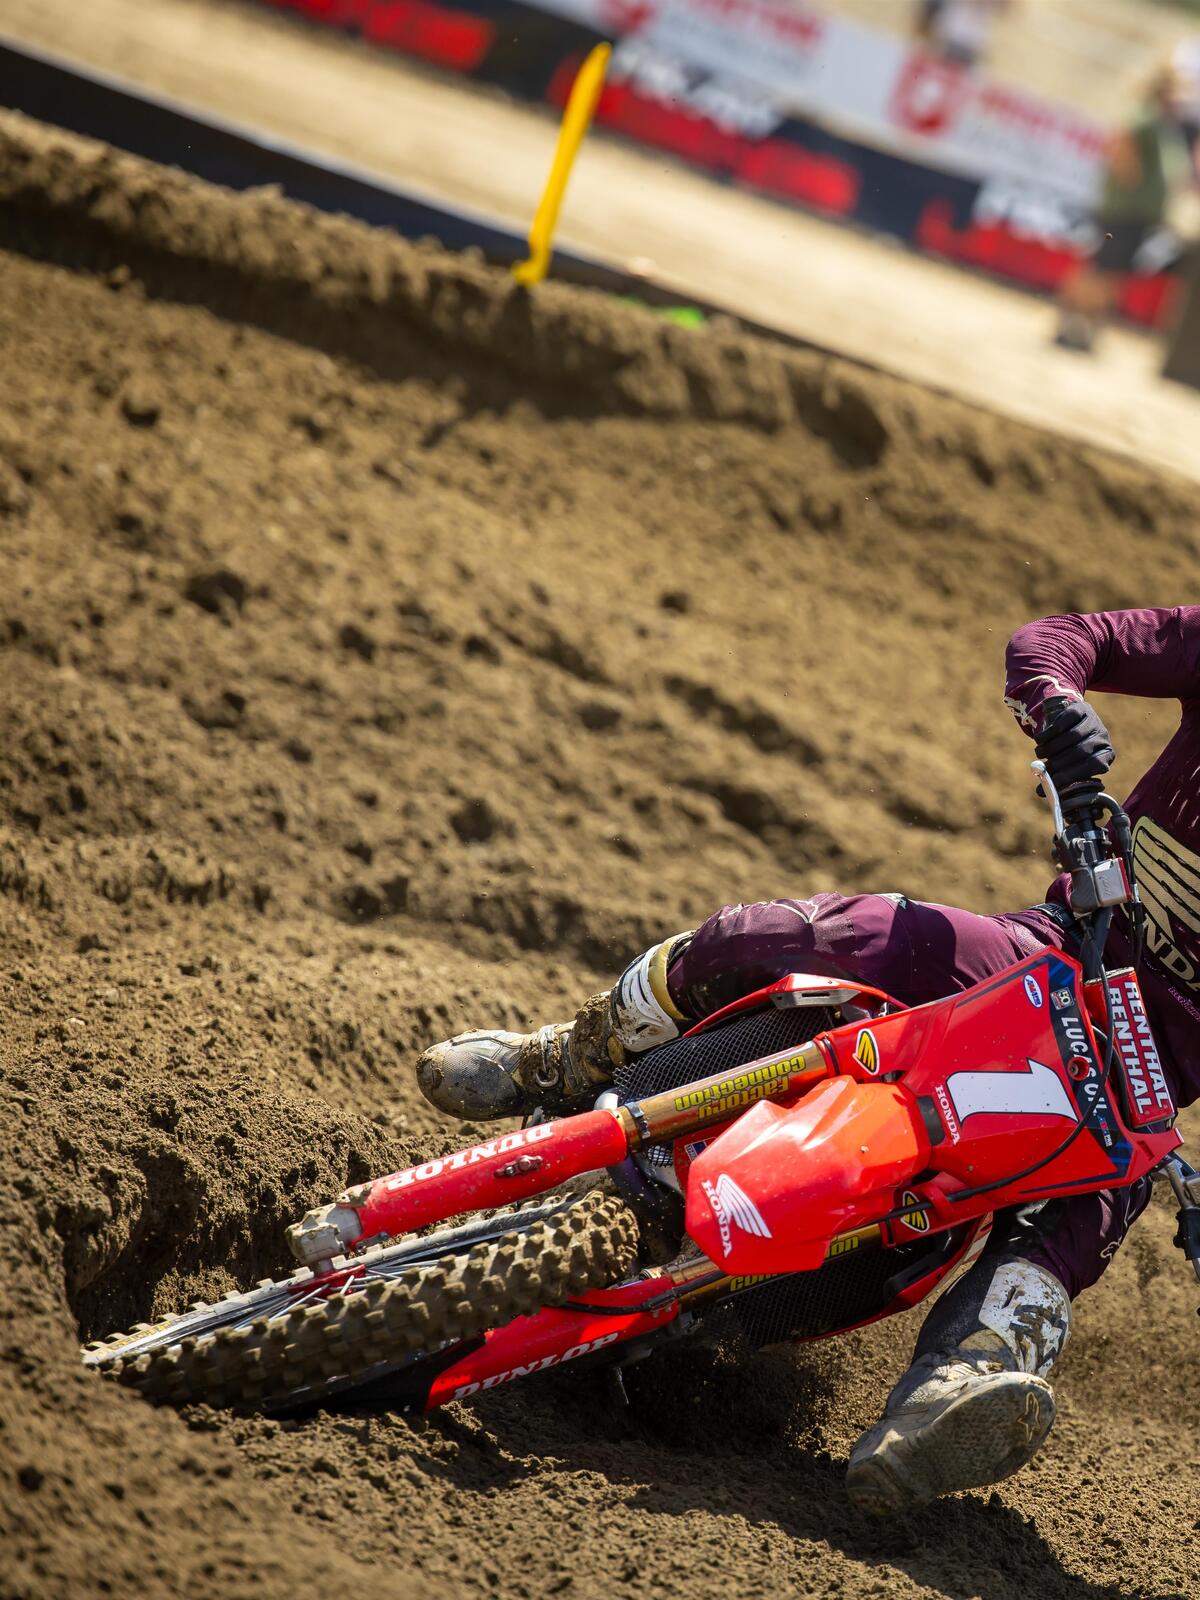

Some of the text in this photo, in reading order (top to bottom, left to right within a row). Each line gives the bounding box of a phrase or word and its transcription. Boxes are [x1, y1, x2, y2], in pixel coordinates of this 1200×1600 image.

[1108, 987, 1152, 1115] RENTHAL
[1124, 980, 1168, 1109] RENTHAL
[934, 1085, 960, 1145] HONDA
[946, 1057, 1079, 1125] 1
[387, 1121, 554, 1191] DUNLOP
[702, 1179, 734, 1258] HONDA
[452, 1332, 620, 1402] DUNLOP
